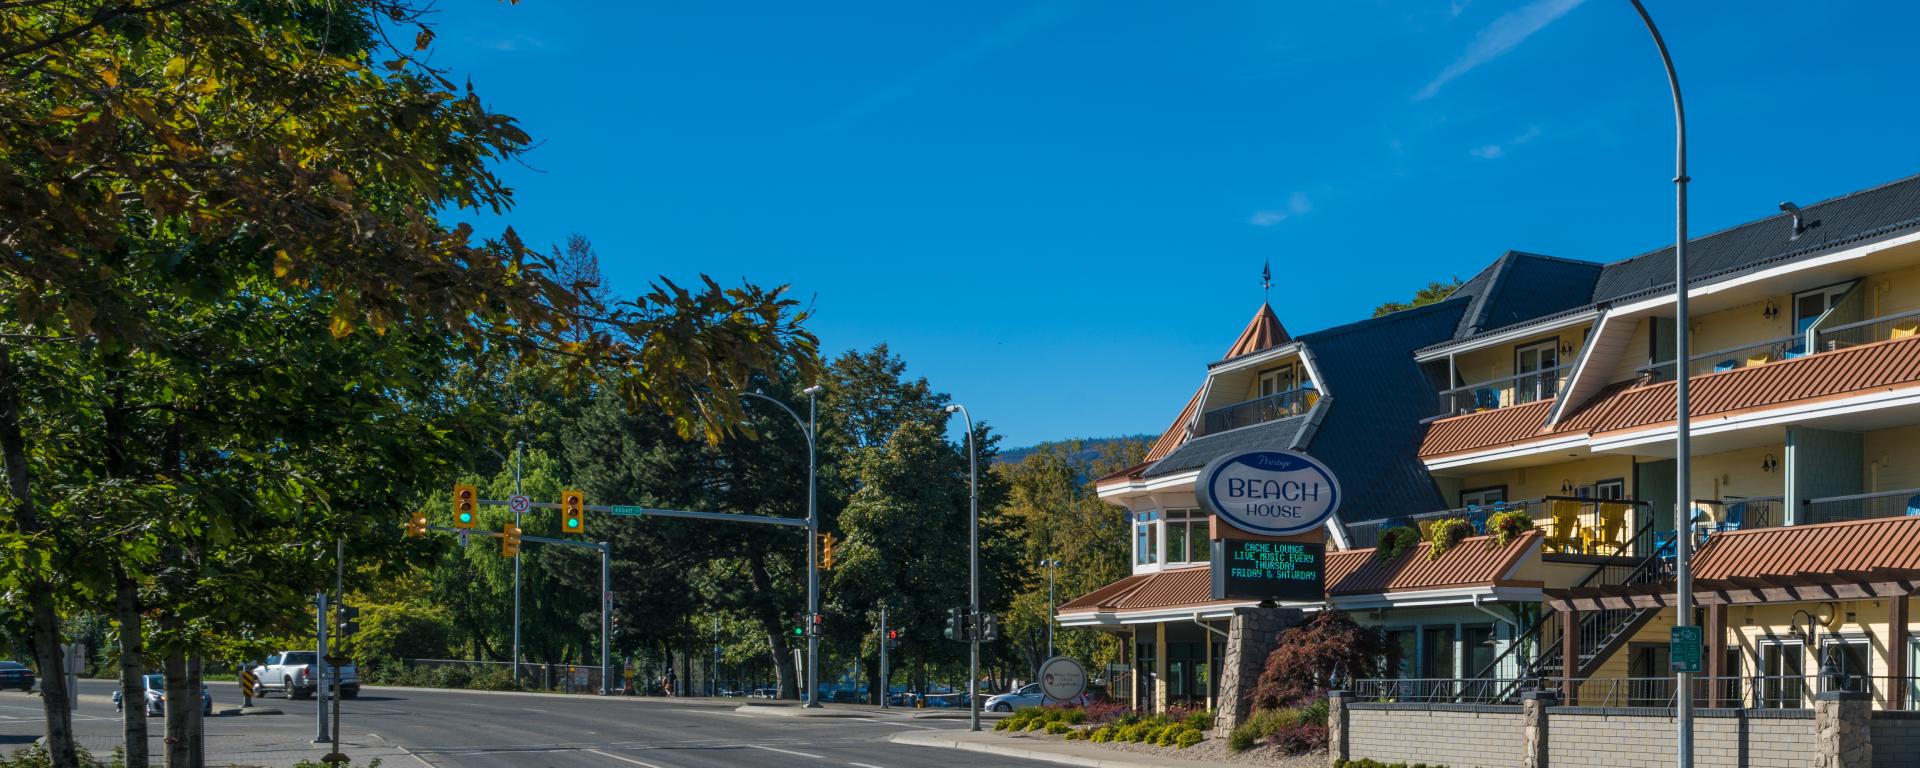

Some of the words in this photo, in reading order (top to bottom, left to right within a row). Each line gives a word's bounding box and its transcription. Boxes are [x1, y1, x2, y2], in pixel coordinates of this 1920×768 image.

[1259, 455, 1291, 469] Prestige
[1228, 478, 1318, 502] BEACH
[1246, 504, 1301, 518] HOUSE
[1244, 543, 1270, 552] CACHE
[1274, 544, 1304, 554] LOUNGE
[1234, 551, 1256, 560] LIVE
[1259, 553, 1285, 562] MUSIC
[1289, 554, 1314, 563] EVERY
[1255, 561, 1295, 570] THURSDAY
[1231, 568, 1263, 578] FRIDAY
[1267, 570, 1273, 578] &
[1276, 570, 1316, 580] SATURDAY
